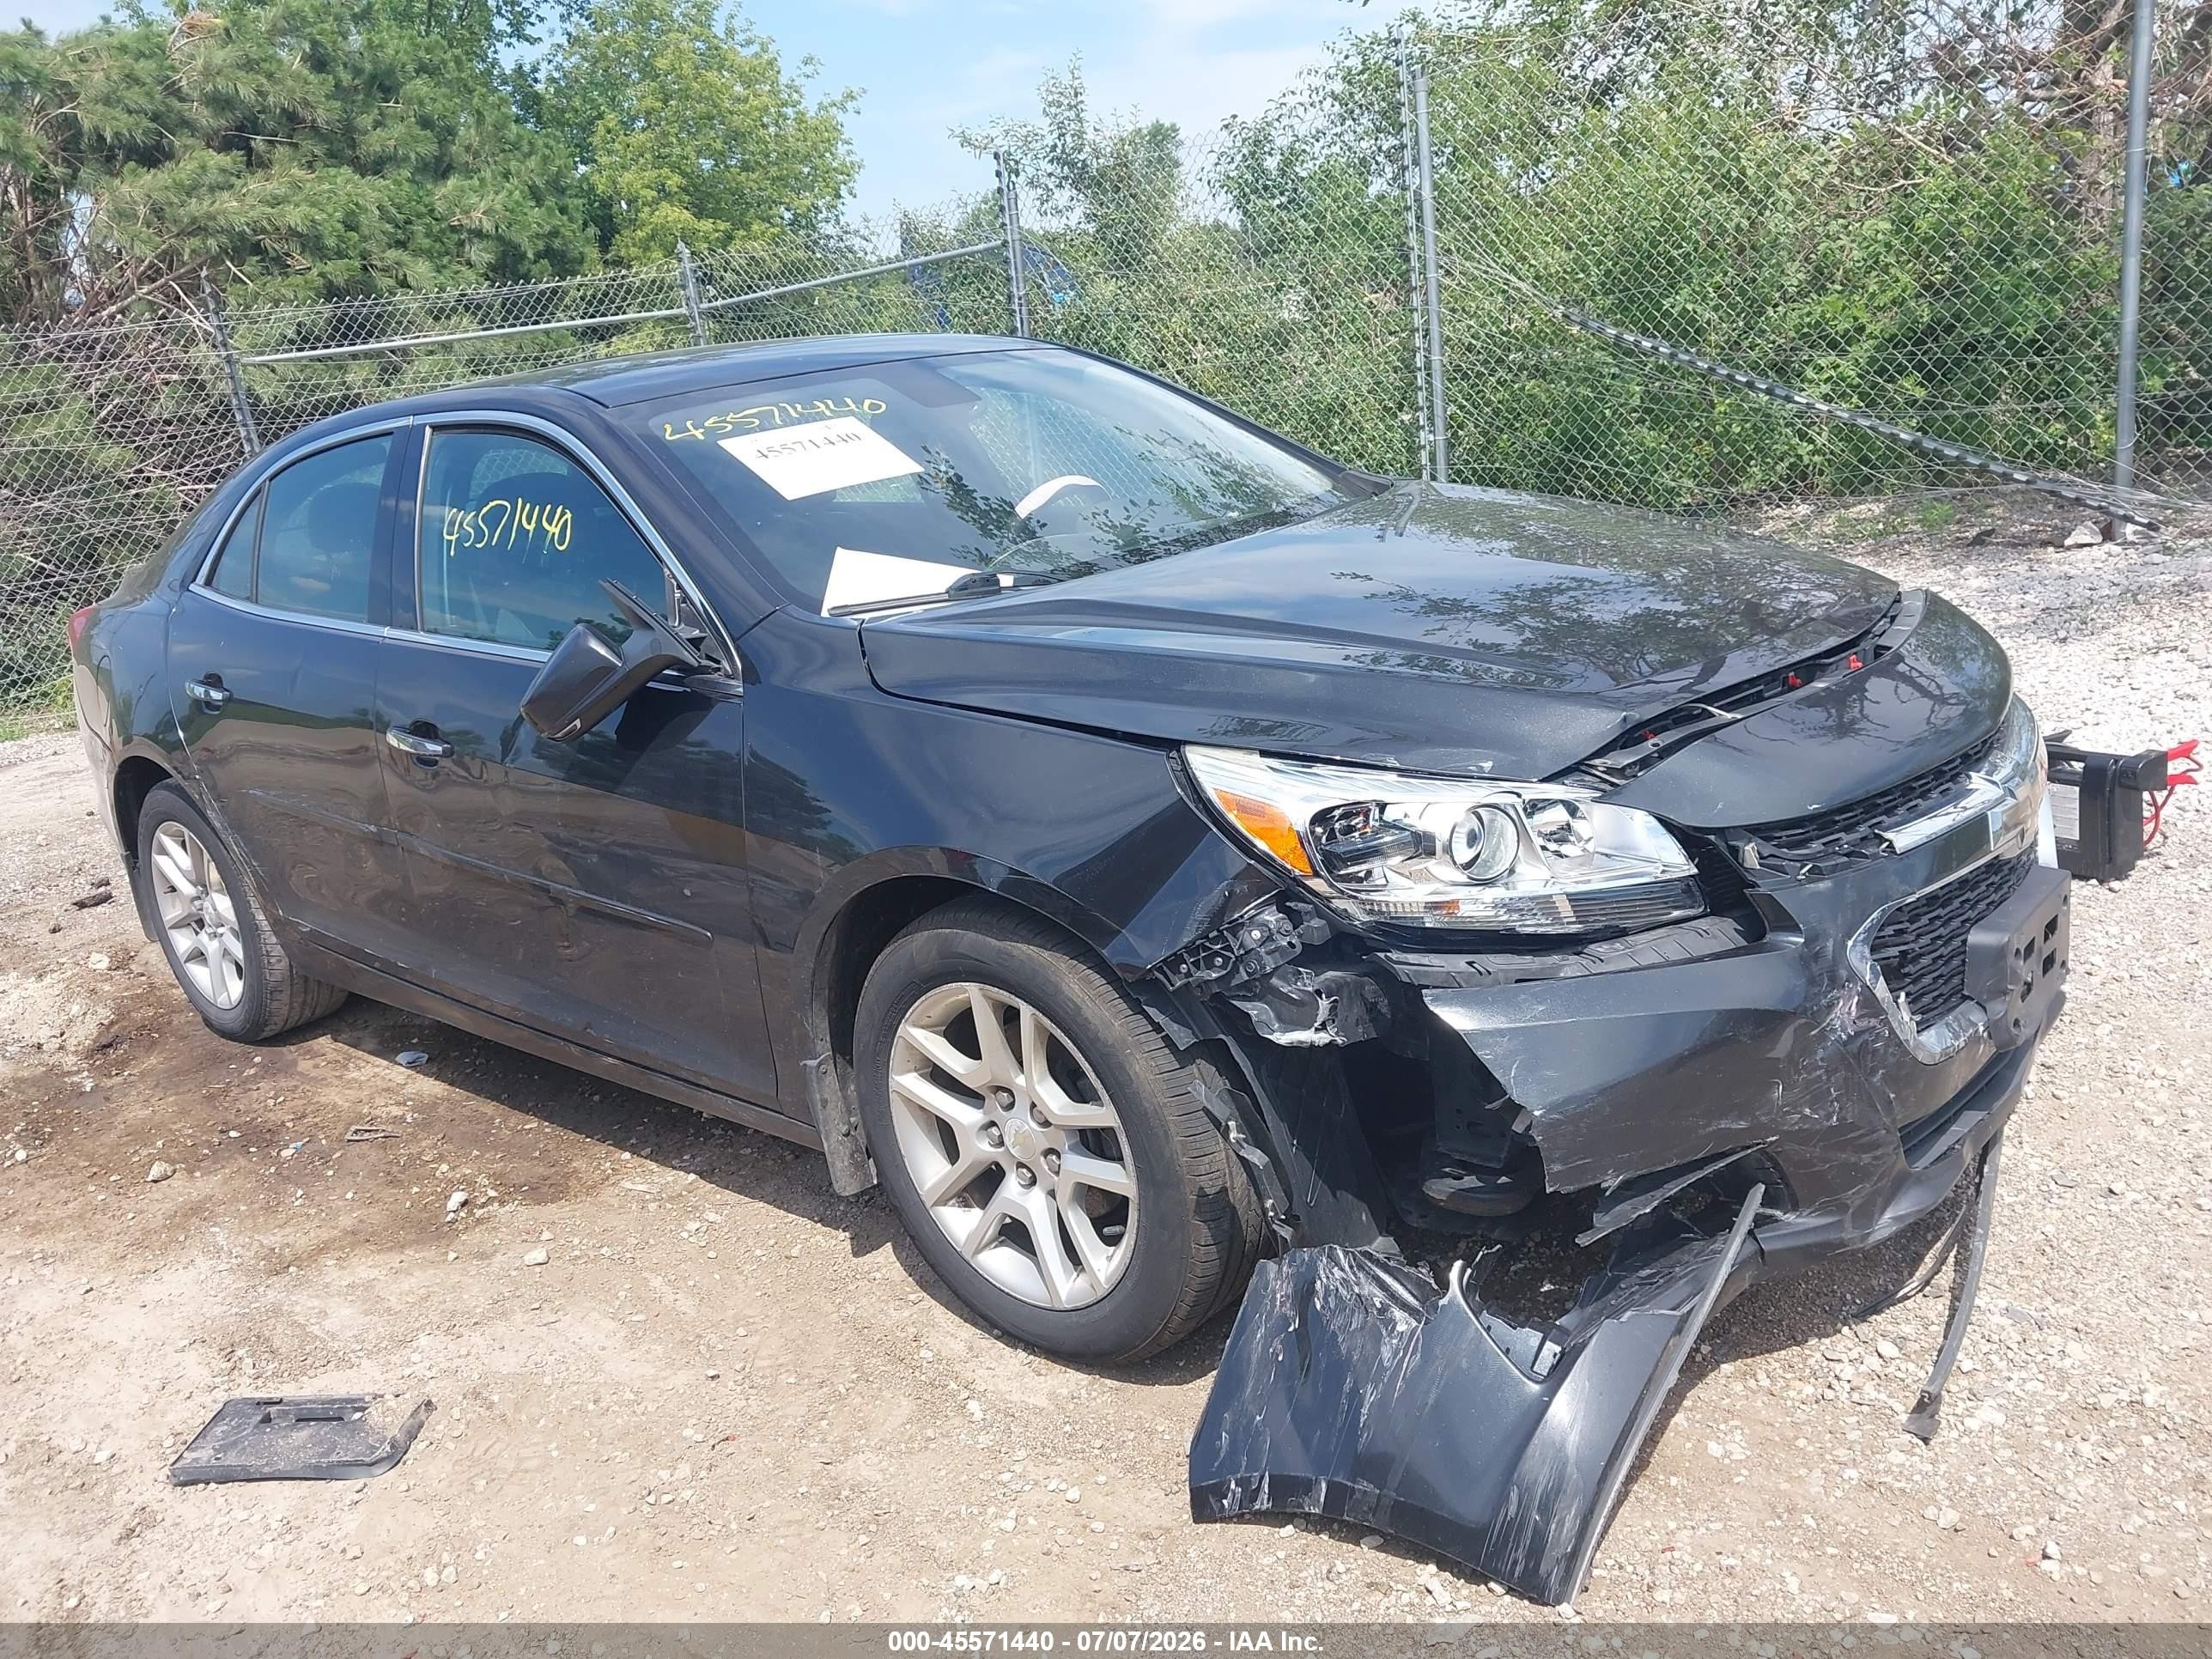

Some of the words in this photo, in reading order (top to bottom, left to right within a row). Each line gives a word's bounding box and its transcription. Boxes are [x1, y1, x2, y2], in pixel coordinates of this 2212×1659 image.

[664, 397, 887, 441] 45571440
[755, 432, 862, 459] 45571440
[443, 497, 573, 557] 45571440
